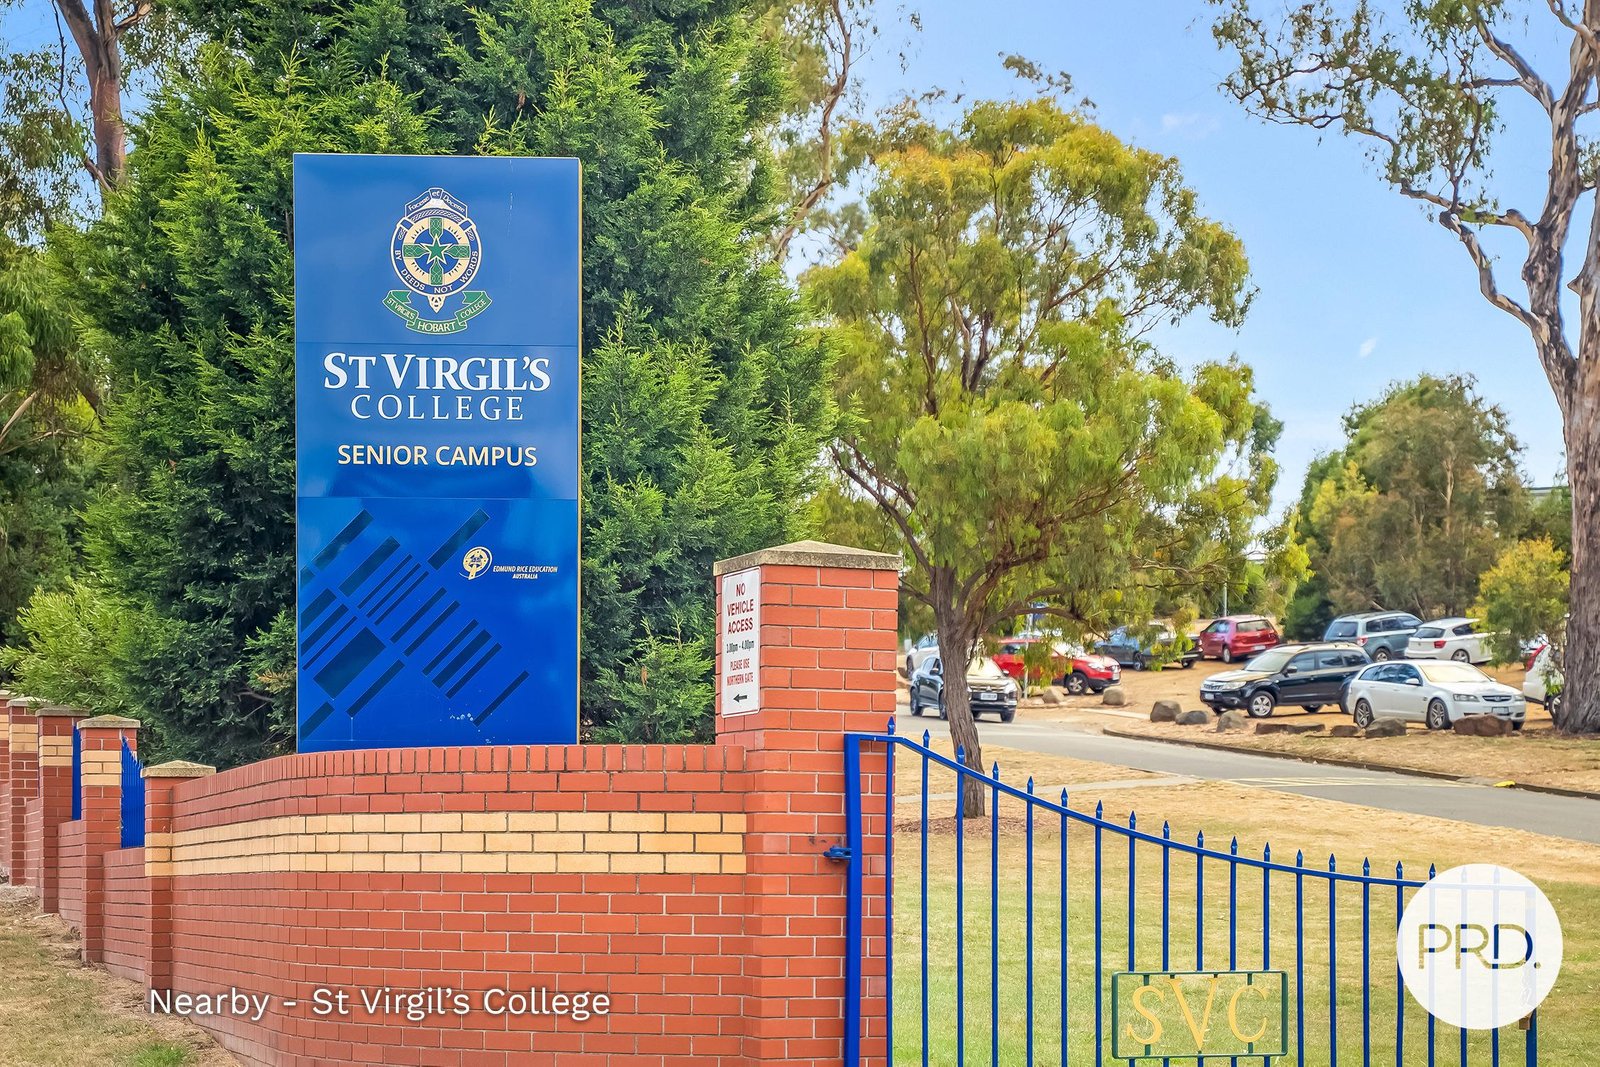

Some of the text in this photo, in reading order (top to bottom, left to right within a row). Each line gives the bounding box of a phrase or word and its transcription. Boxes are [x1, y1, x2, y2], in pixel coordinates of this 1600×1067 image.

[394, 250, 478, 294] BY DEEDS NOT WORDS
[417, 320, 456, 333] HOBART
[460, 299, 487, 318] COLLEGE
[323, 352, 551, 391] ST VIRGIL’S
[351, 394, 523, 421] COLLEGE
[337, 444, 537, 467] SENIOR CAMPUS
[493, 565, 558, 573] EDMUND RICE EDUCATION
[736, 582, 746, 597] NO
[727, 598, 754, 616] VEHICLE
[728, 617, 754, 635] ACCESS
[730, 659, 742, 671] PLEASE
[726, 671, 754, 686] NORTHERN GATE
[1126, 977, 1269, 1050] SVC
